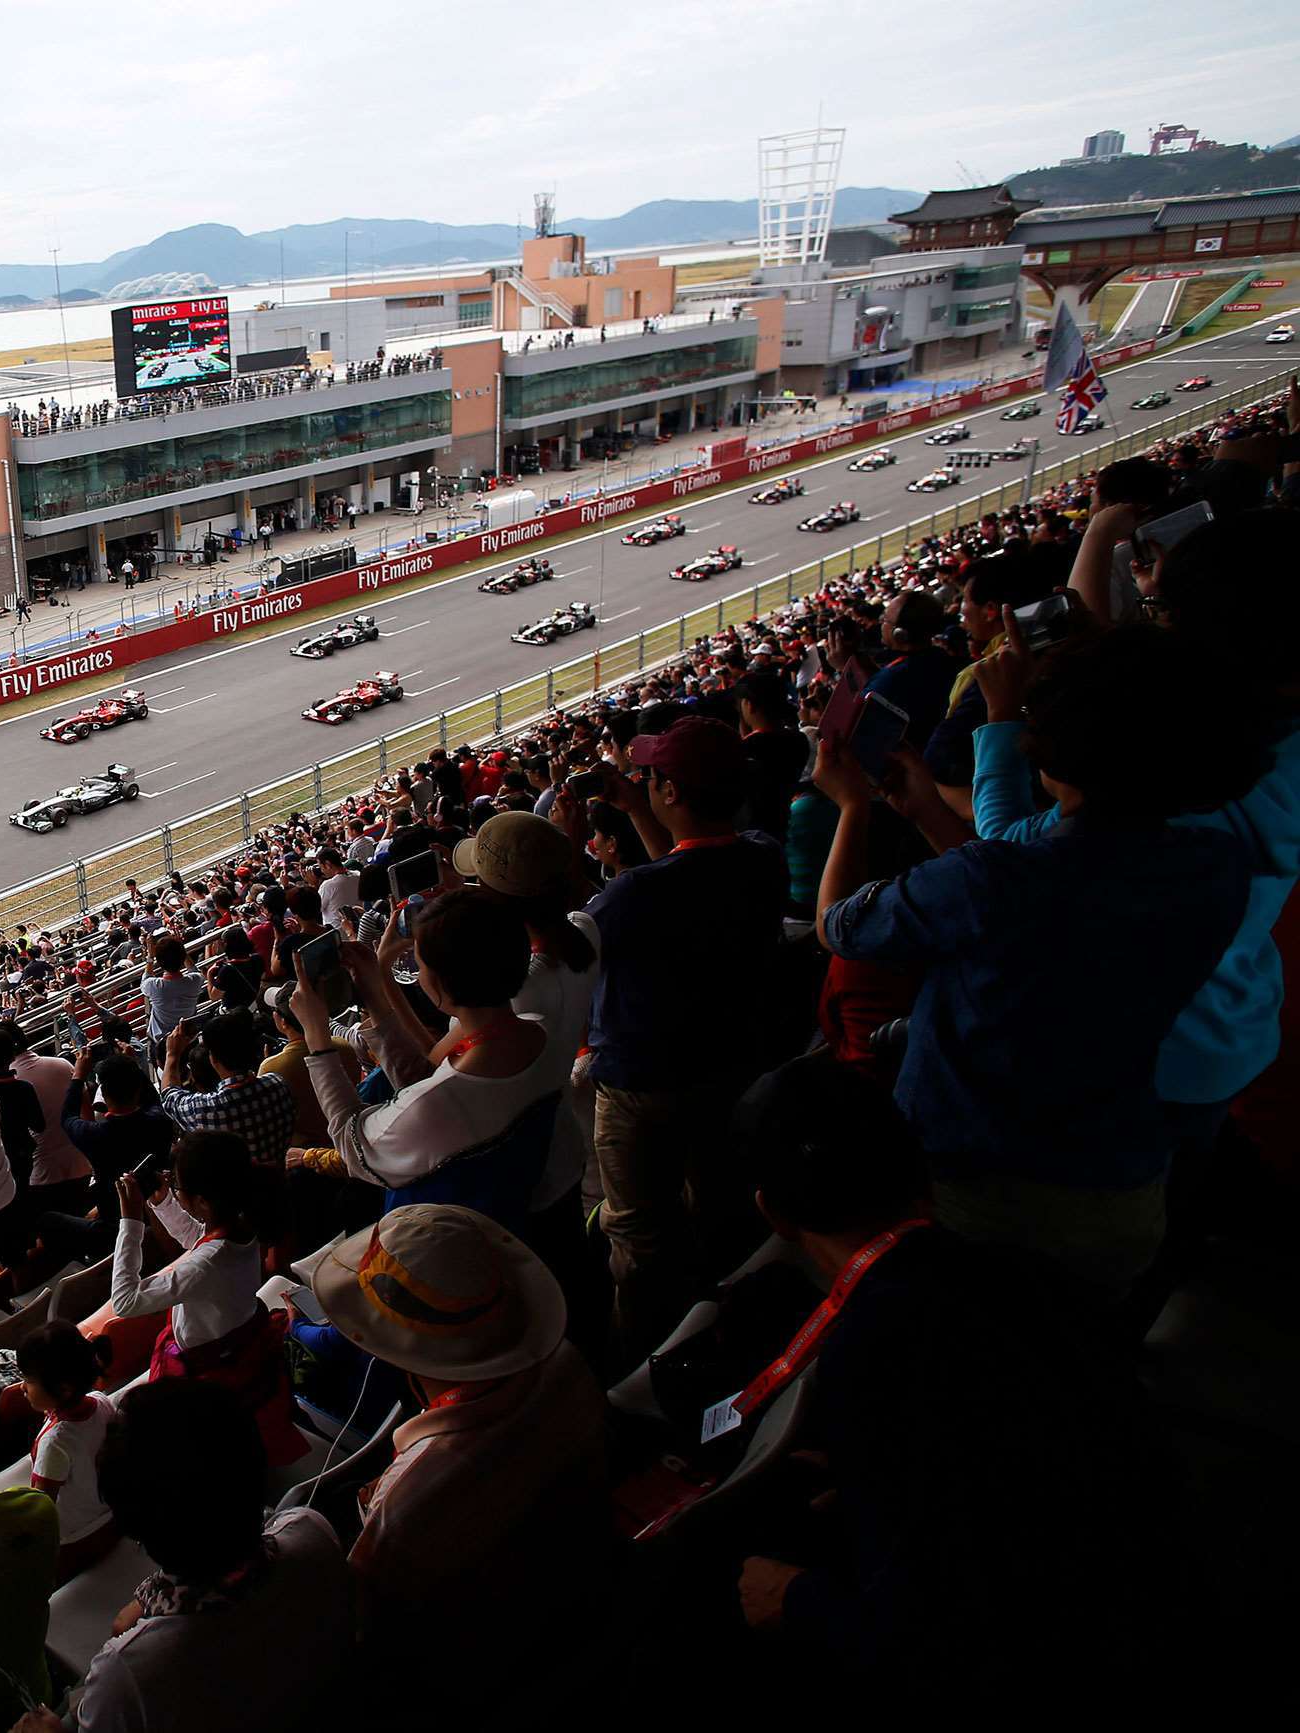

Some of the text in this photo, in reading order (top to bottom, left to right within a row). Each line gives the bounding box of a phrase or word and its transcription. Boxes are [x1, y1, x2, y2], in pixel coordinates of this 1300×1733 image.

[749, 449, 792, 472] Fly Emirates
[673, 471, 721, 496] Fly Emirates
[581, 495, 635, 523] Fly Emirates
[481, 521, 545, 552] Fly Emirates
[358, 554, 433, 589] Fly Emirates
[213, 592, 302, 633] Fly Emirates
[0, 649, 113, 697] Fly Emirates
